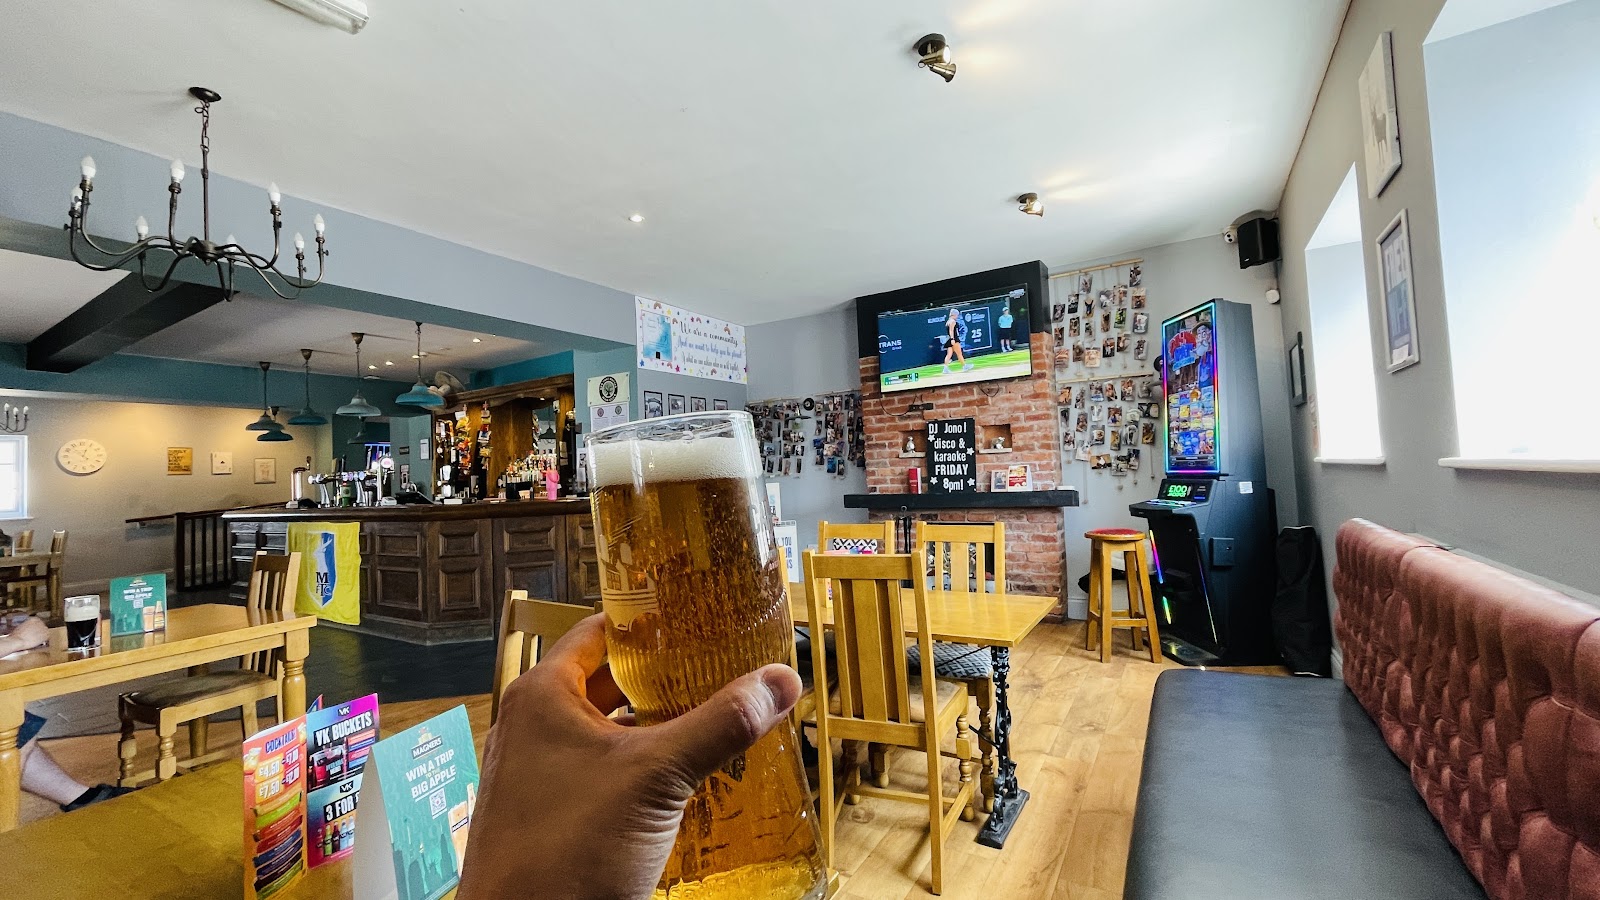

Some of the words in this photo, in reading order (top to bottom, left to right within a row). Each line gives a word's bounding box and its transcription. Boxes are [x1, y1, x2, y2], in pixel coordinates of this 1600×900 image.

[680, 321, 691, 334] We
[693, 328, 702, 336] are
[710, 333, 738, 348] community
[971, 329, 982, 339] 25
[928, 423, 938, 434] DJ
[944, 422, 967, 433] Jono!
[934, 438, 956, 449] disco
[959, 438, 965, 448] &
[934, 450, 966, 462] karaoke
[935, 464, 968, 475] FRIDAY
[943, 478, 964, 493] 8pm!
[316, 572, 329, 583] M
[339, 706, 349, 715] VK
[316, 728, 330, 746] VK
[332, 712, 372, 740] BUCKETS
[413, 738, 442, 757] MAGNERS
[406, 763, 427, 782] WIN
[428, 760, 434, 771] A
[434, 749, 454, 766] TRIP
[341, 783, 352, 791] VK
[411, 780, 428, 798] BIG
[429, 764, 456, 788] APPLE
[326, 805, 333, 820] 3
[335, 795, 354, 817] FOR
